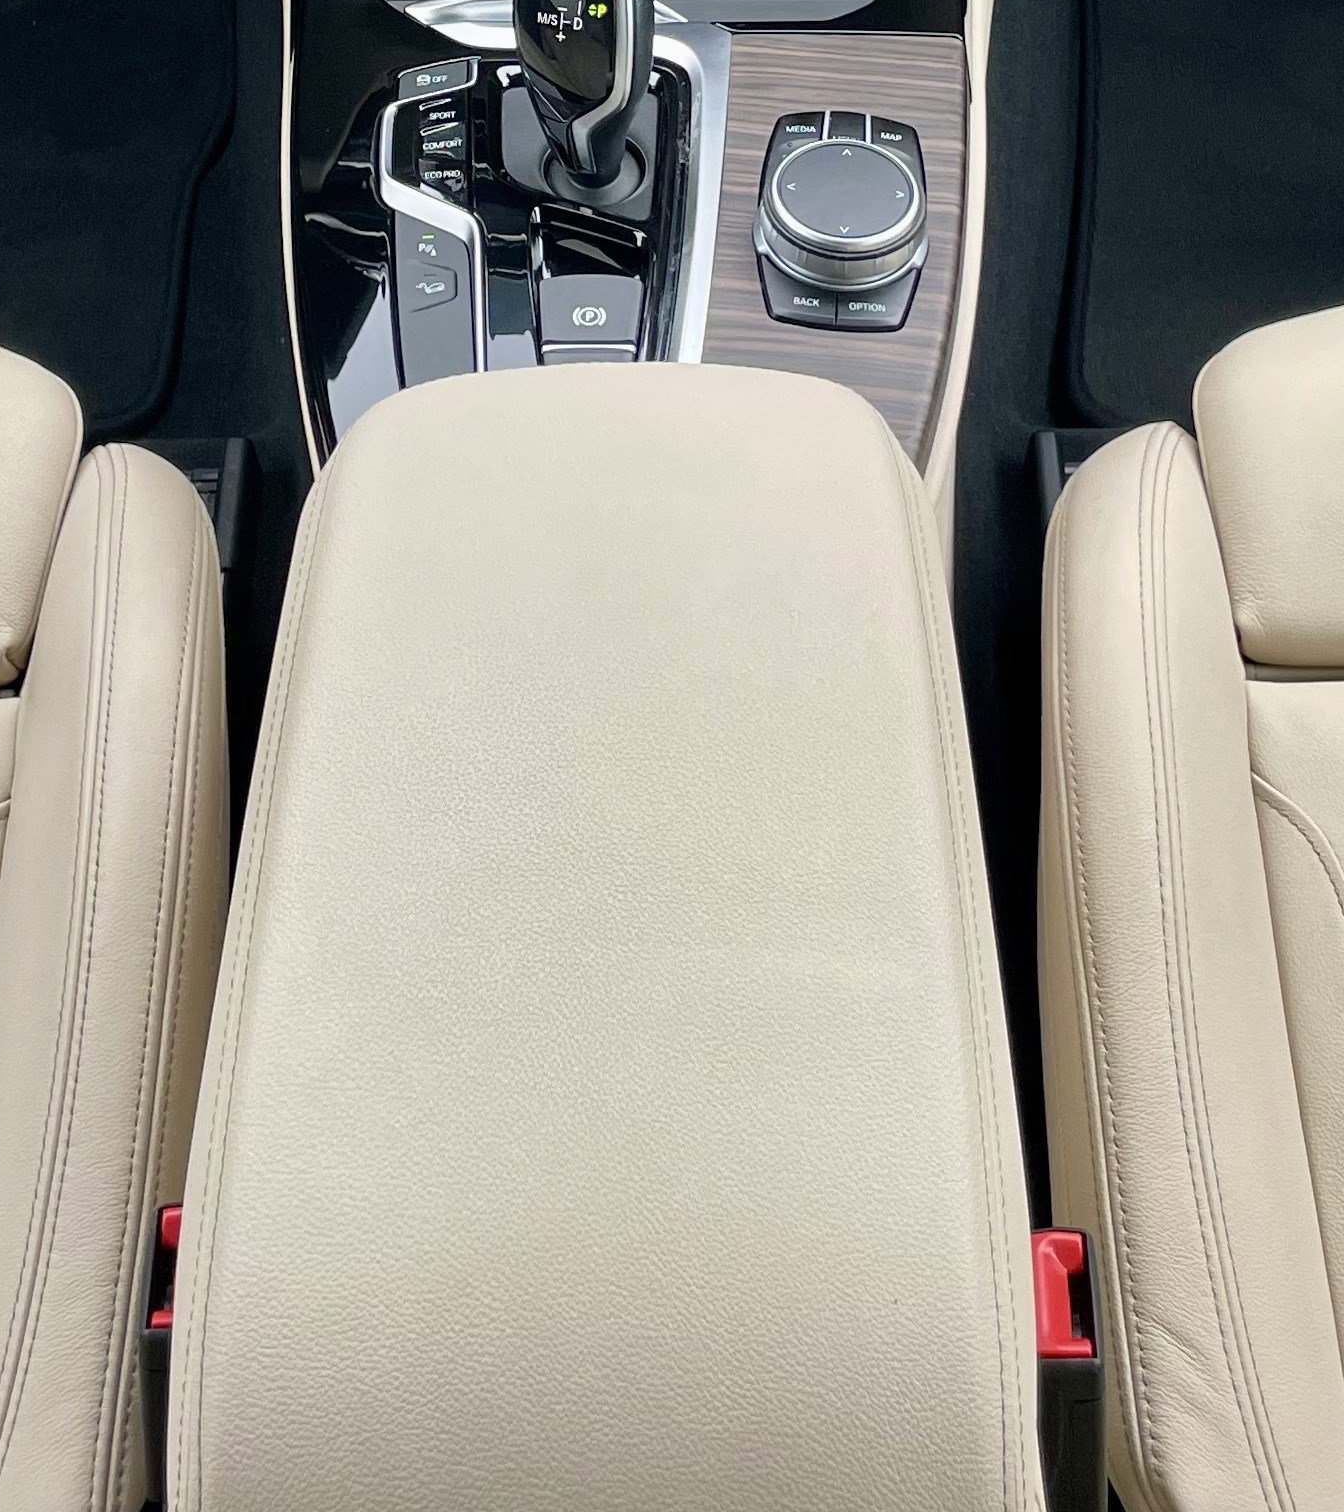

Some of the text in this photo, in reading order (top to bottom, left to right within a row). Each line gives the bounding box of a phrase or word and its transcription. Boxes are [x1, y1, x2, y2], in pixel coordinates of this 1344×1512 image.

[537, 13, 558, 27] M/S
[573, 18, 583, 31] D
[431, 75, 448, 83] OFF
[429, 110, 456, 120] SPORT
[785, 124, 817, 134] MEDIA
[880, 131, 903, 142] MAP
[422, 137, 463, 151] COMFORT
[424, 171, 442, 181] ECO
[793, 296, 820, 308] BACK
[848, 301, 887, 313] OPTION
